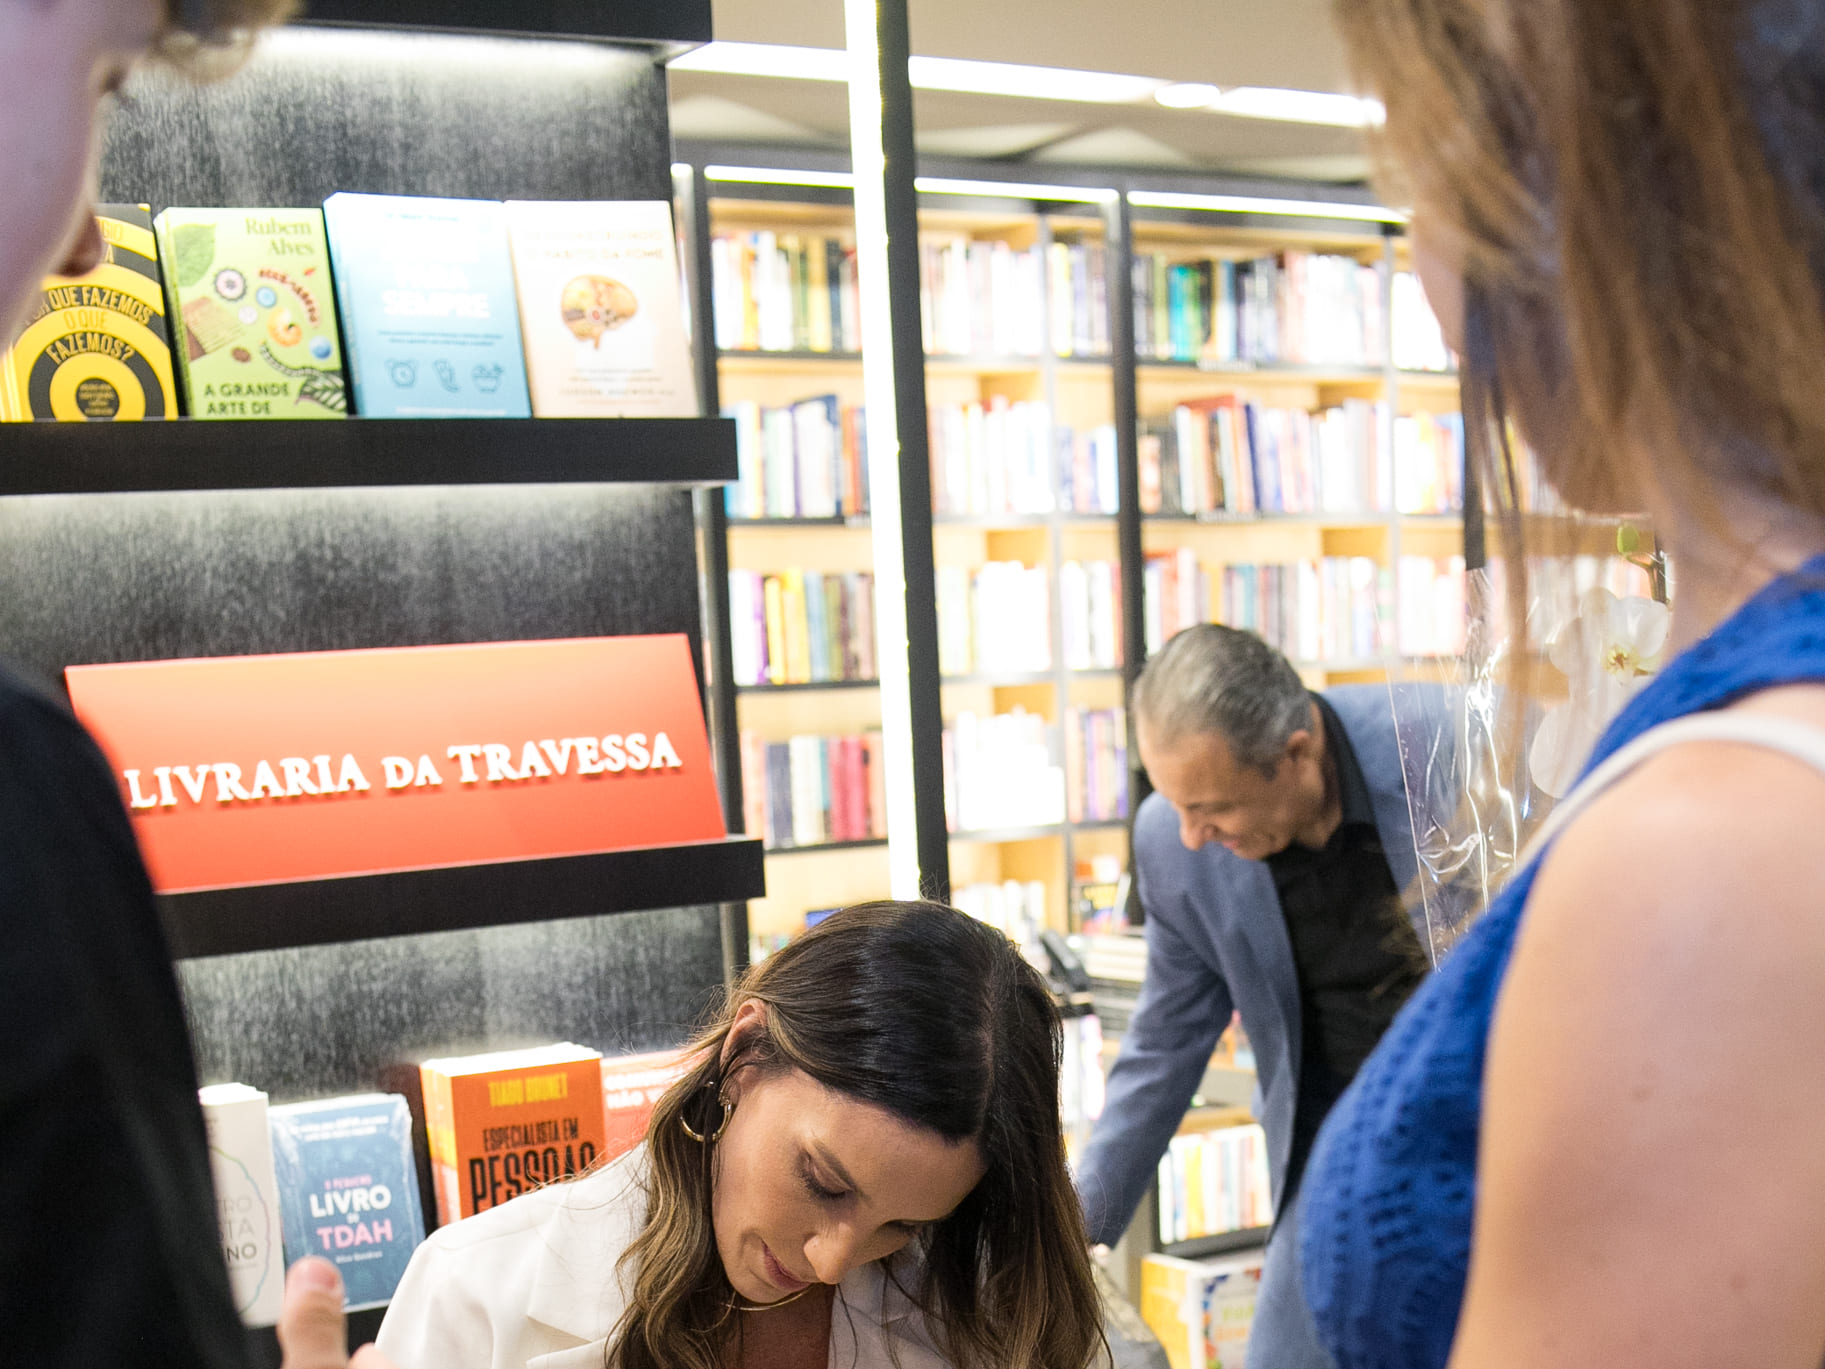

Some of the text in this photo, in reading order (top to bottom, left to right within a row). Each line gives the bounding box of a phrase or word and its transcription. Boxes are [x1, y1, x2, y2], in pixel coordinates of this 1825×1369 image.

[245, 217, 312, 236] Rubem
[268, 237, 314, 256] Alves
[48, 287, 80, 311] QUE
[81, 286, 153, 326] FAZEMOS
[63, 308, 108, 330] O QUE
[45, 332, 135, 365] FAZEMOS?
[205, 382, 289, 397] A GRANDE
[206, 402, 271, 416] ARTE DE
[125, 732, 683, 809] LIVRARIA DA TRAVESSA
[482, 1117, 579, 1153] ESPECIALISTA EM
[309, 1184, 392, 1218] LIVRO
[316, 1218, 394, 1251] TDAH
